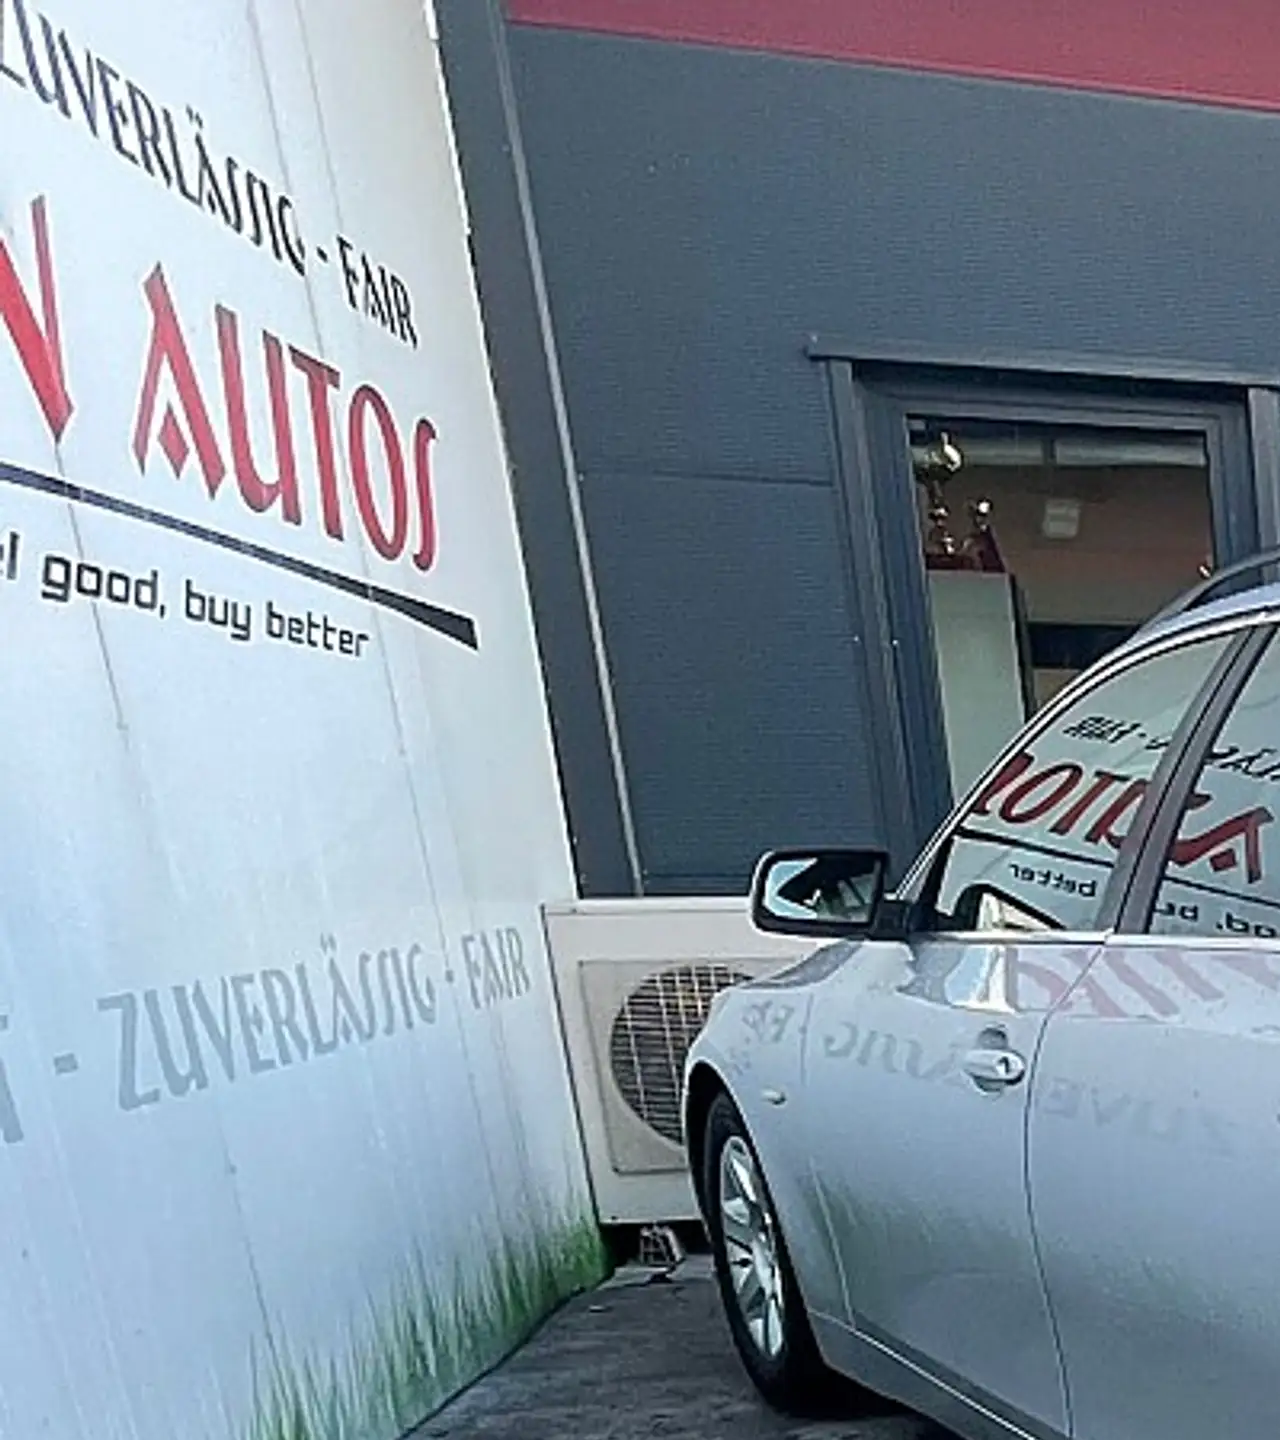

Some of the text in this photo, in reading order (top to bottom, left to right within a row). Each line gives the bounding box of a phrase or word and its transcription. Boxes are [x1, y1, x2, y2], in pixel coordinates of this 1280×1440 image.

[336, 235, 418, 349] FAIR
[133, 262, 438, 572] AUTOS
[42, 554, 167, 617] good,
[184, 580, 252, 641] buy
[266, 601, 371, 657] better
[97, 934, 437, 1113] ZUVERLÄSSIG
[460, 926, 532, 1010] FAIR
